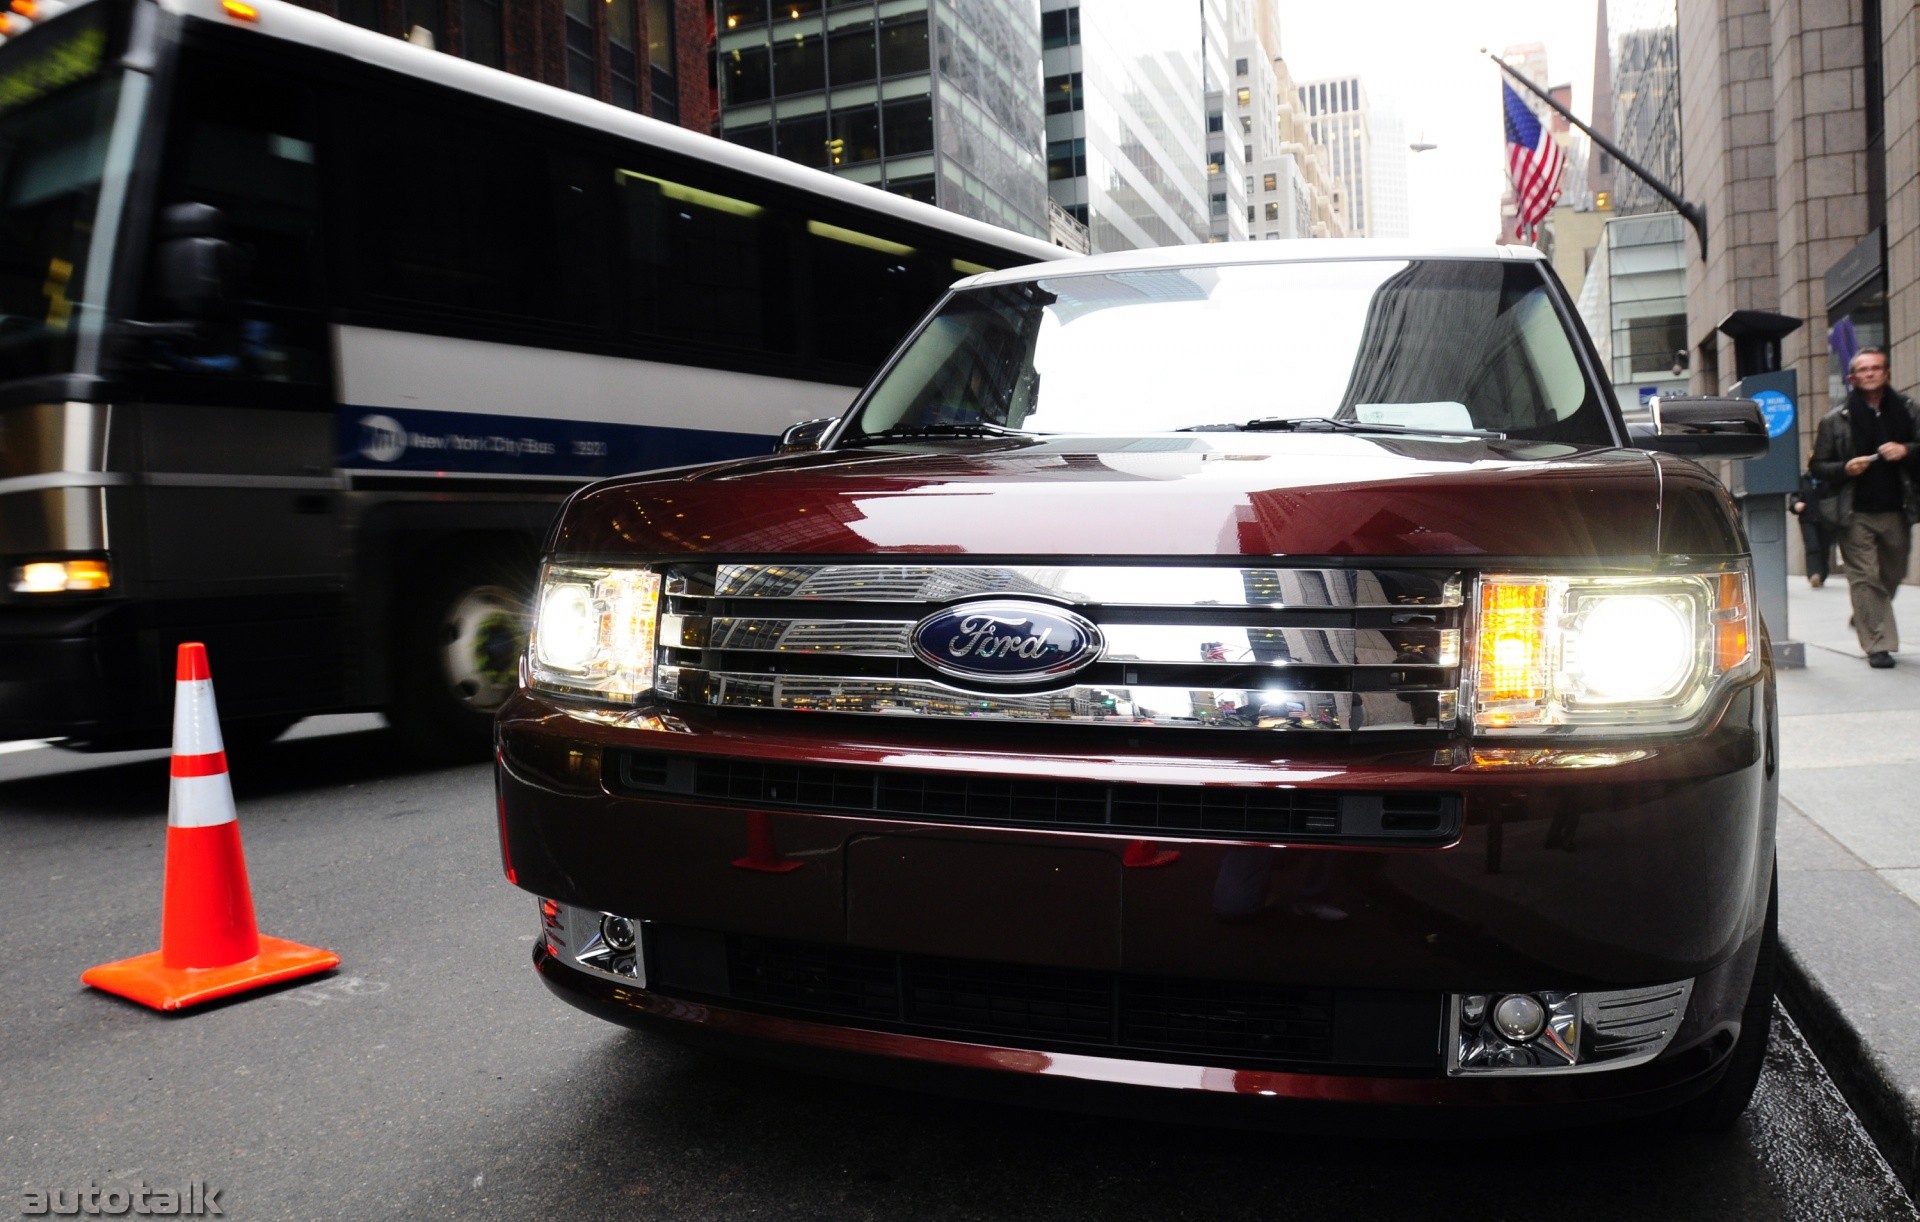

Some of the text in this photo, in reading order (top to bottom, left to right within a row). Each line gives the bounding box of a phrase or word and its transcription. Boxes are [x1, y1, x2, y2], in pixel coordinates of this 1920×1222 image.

[410, 432, 556, 456] New York City Bus
[949, 614, 1052, 659] Ford
